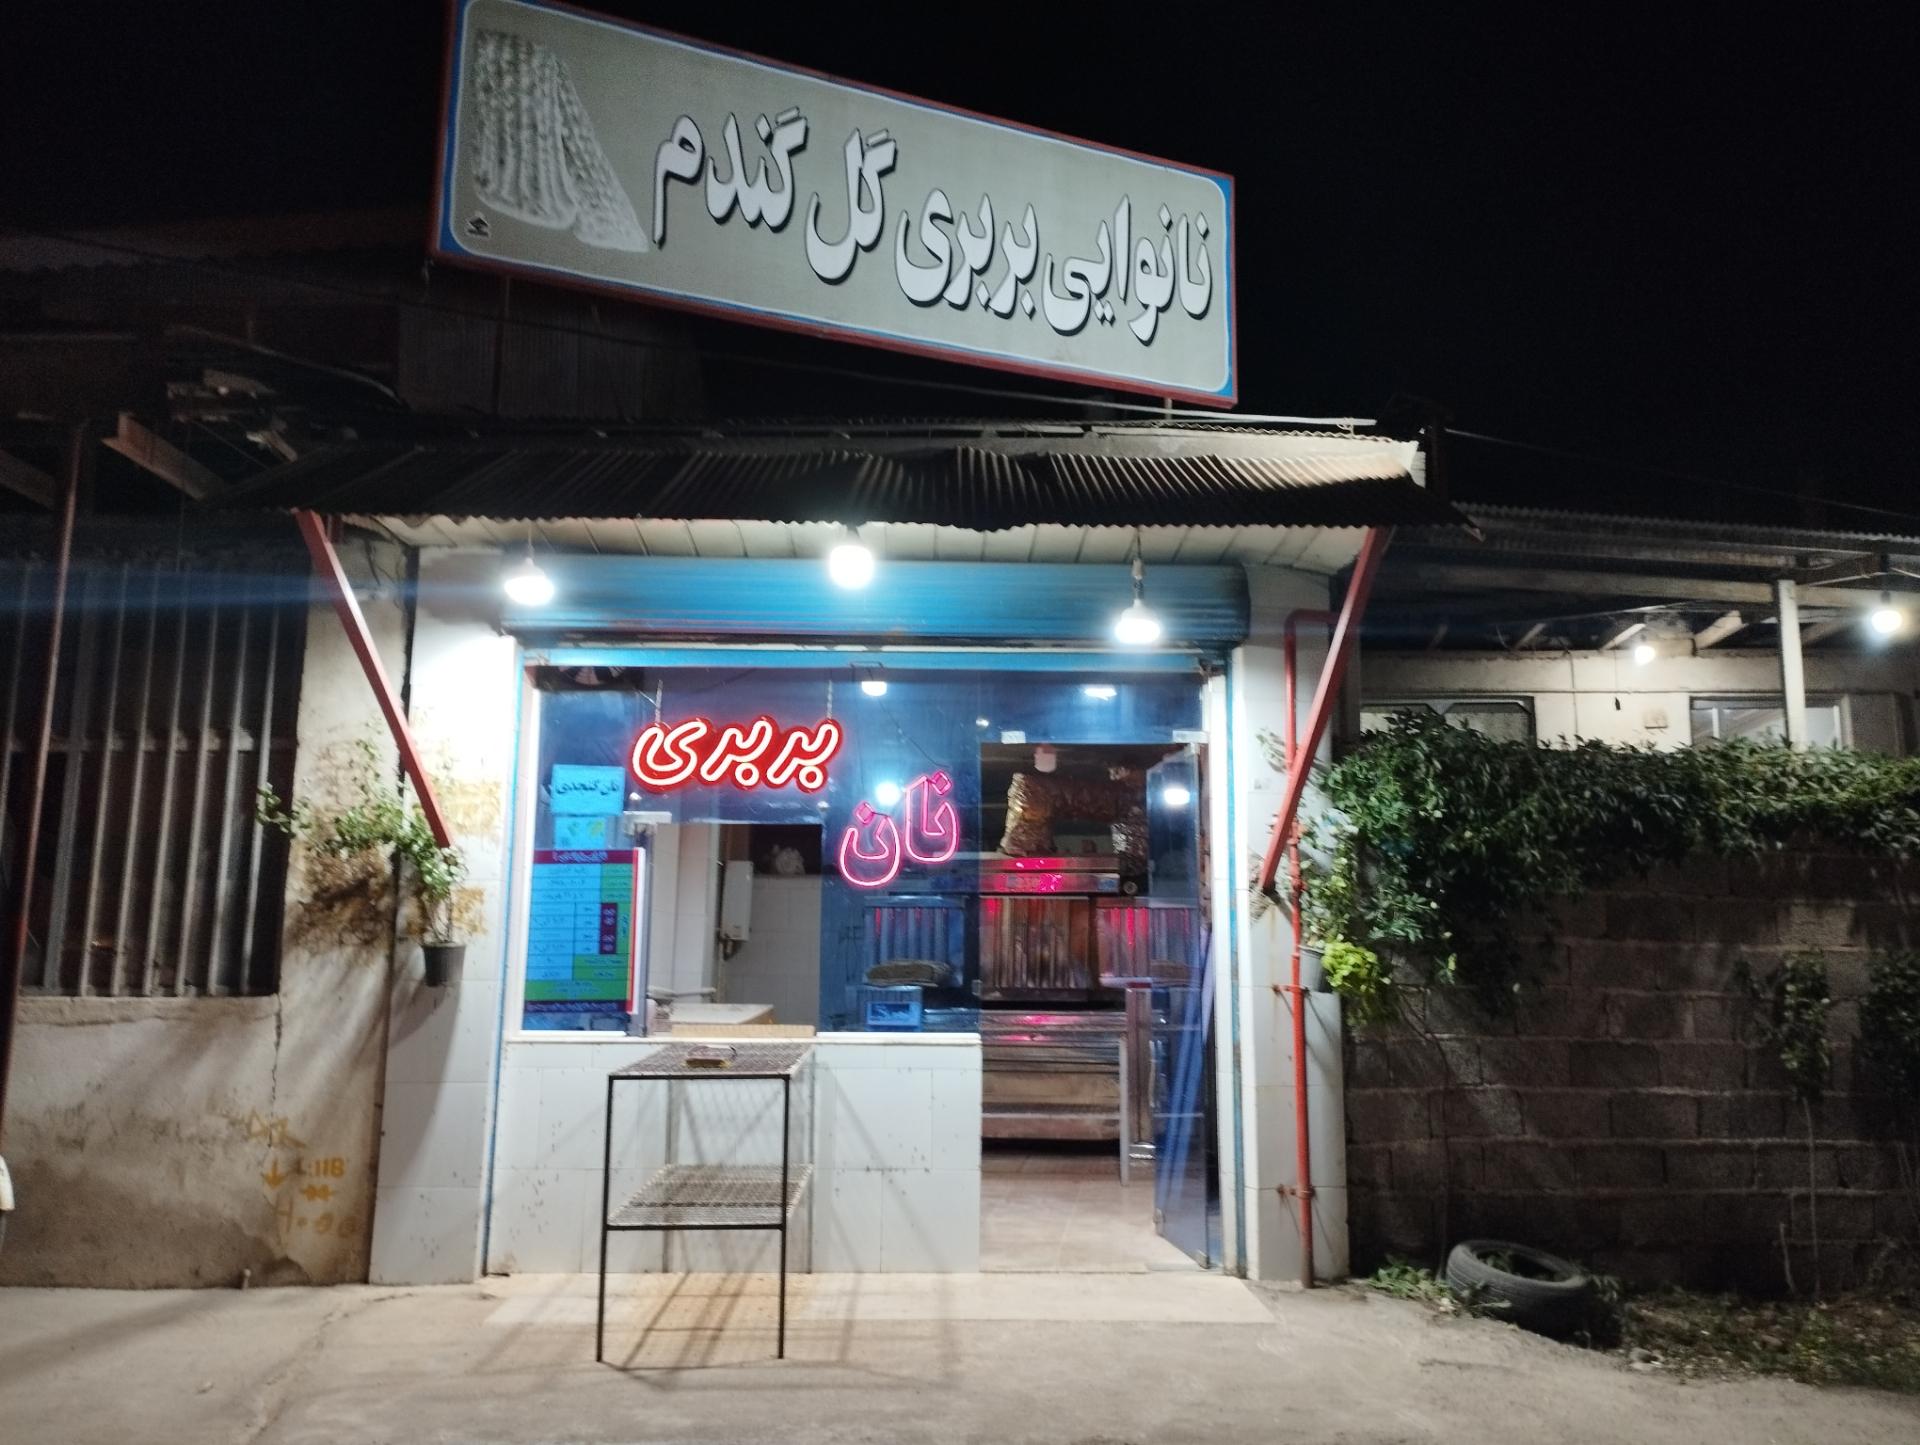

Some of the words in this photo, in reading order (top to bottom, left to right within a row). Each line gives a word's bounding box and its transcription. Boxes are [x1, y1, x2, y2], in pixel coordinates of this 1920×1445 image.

[652, 106, 807, 249] گندم
[805, 127, 897, 285] گل
[894, 188, 1038, 318] بربری
[1042, 194, 1212, 346] نانوایی
[631, 717, 839, 790] بربری
[840, 770, 957, 887] نان
